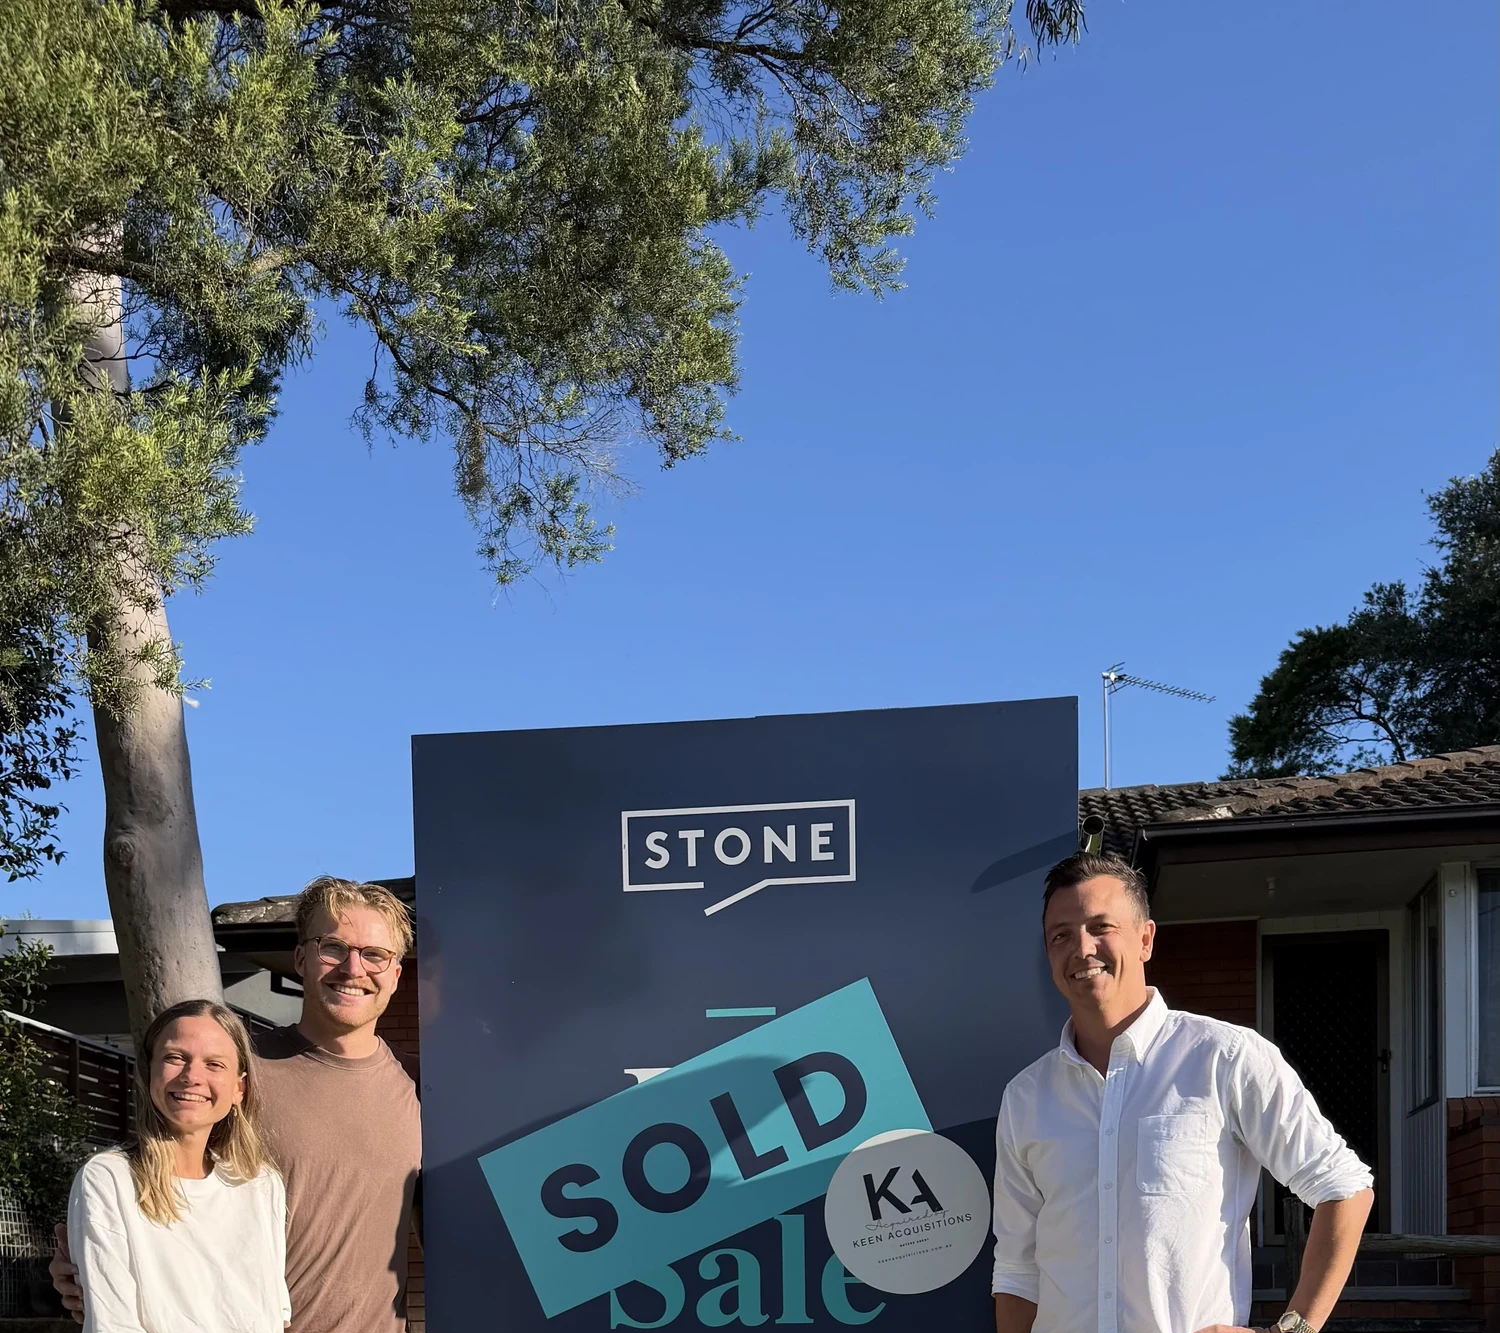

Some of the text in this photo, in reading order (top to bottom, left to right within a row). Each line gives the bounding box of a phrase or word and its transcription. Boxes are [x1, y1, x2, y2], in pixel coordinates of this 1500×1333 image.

[644, 823, 834, 869] STONE
[540, 1051, 867, 1253] SOLD
[863, 1166, 944, 1221] KA
[852, 1213, 972, 1248] KEEN ACQUISITIONS
[865, 1209, 933, 1231] Acquired
